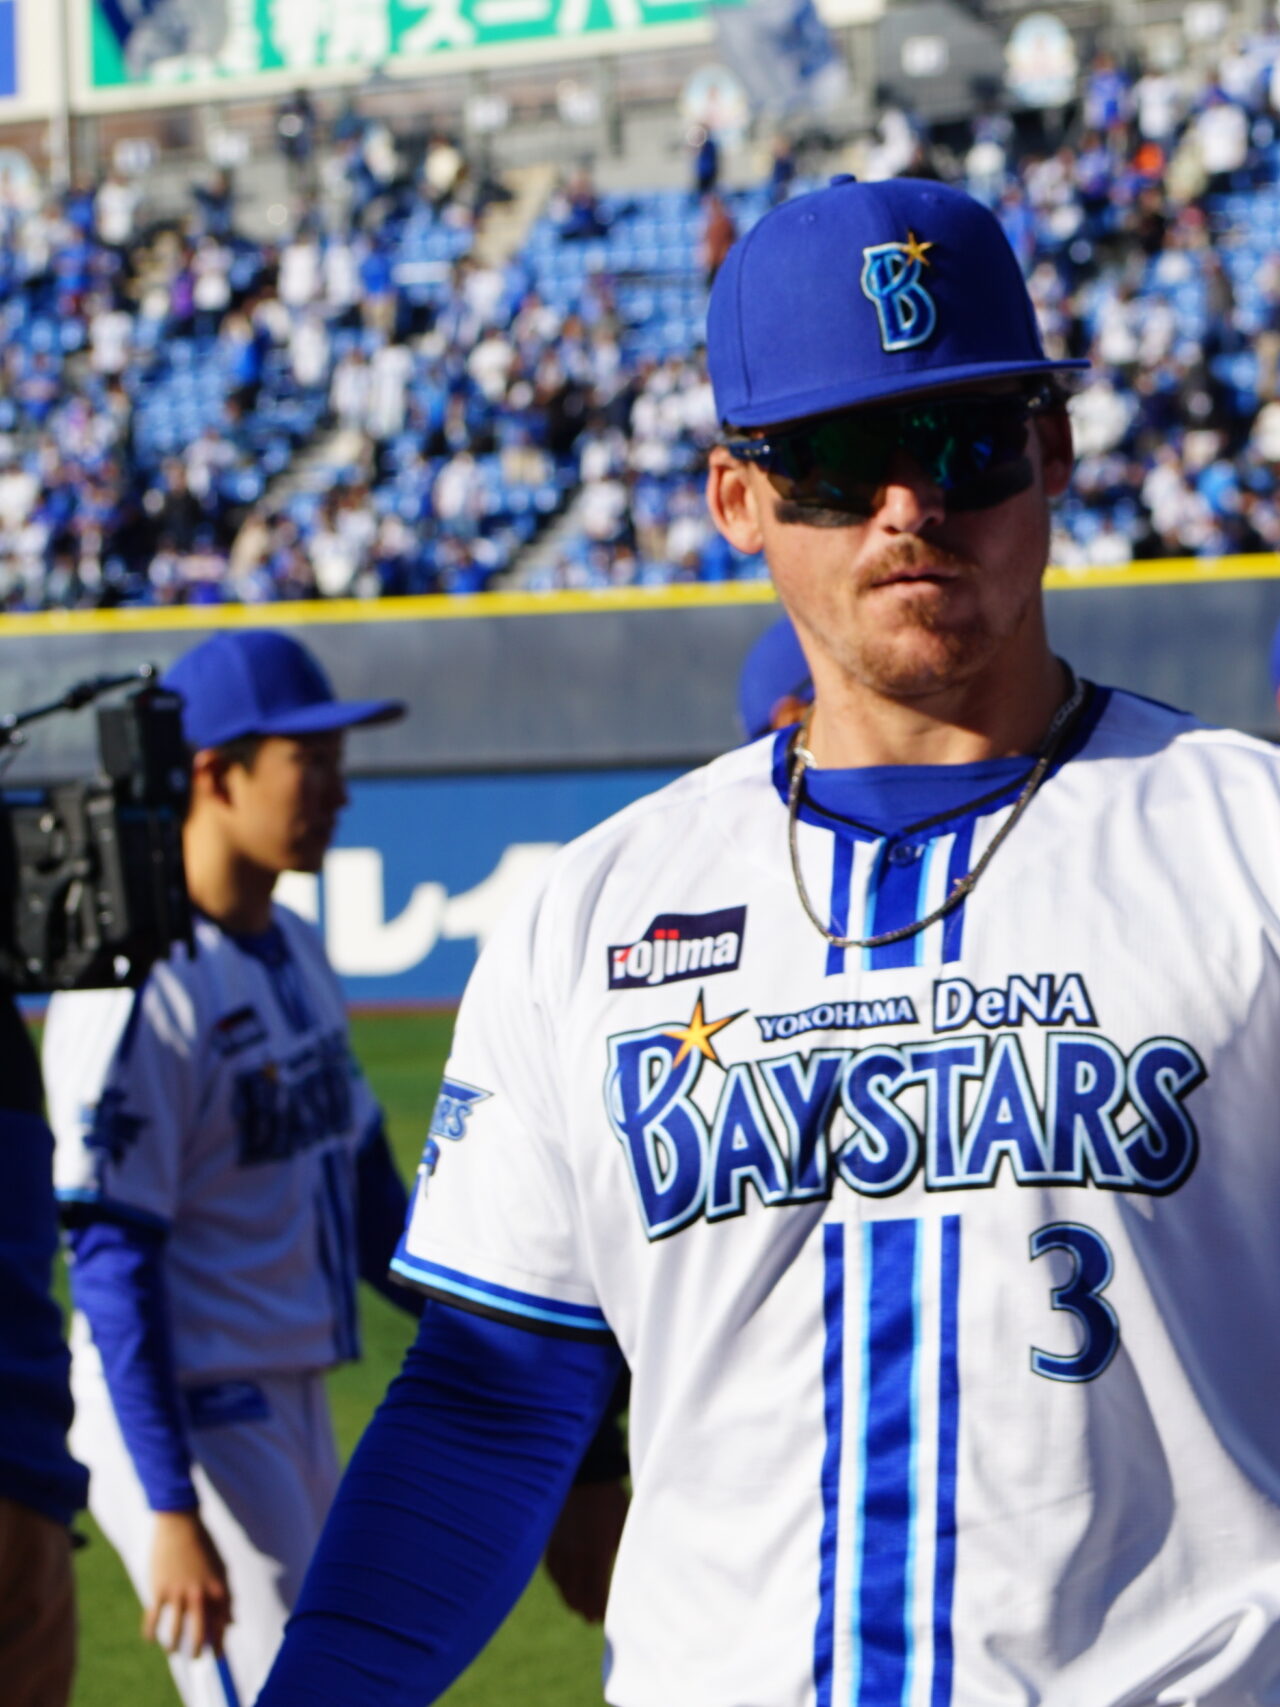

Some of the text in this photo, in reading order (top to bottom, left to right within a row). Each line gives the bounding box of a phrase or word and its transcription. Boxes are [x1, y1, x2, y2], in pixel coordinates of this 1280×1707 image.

[861, 241, 937, 352] B
[757, 973, 1099, 1041] YOKOHAMA DeNA
[604, 1024, 1207, 1242] BAYSTARS
[1030, 1222, 1119, 1382] 3
